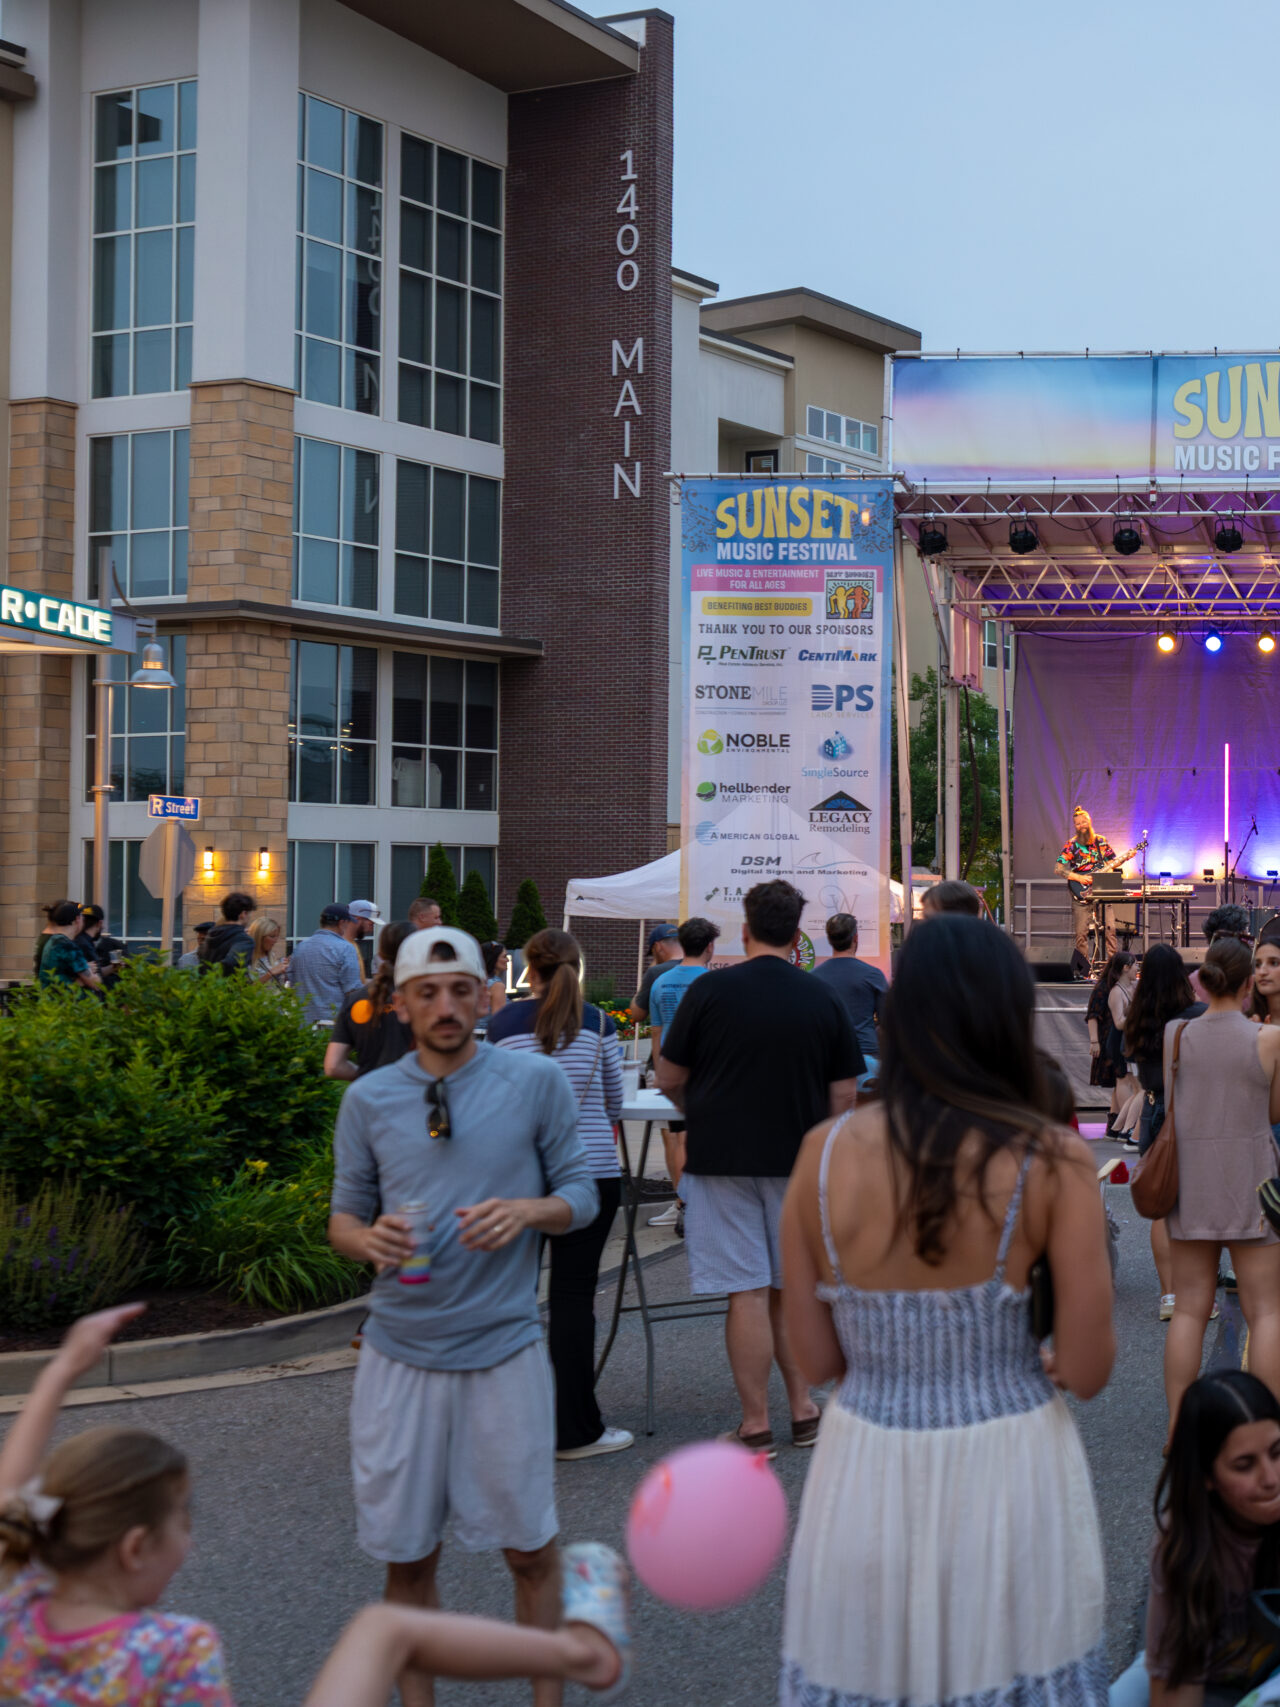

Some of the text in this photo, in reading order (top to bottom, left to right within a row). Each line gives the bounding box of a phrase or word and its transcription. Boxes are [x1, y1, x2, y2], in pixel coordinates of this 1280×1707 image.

[616, 150, 640, 291] 1400
[612, 338, 644, 499] MAIN
[1175, 445, 1260, 471] MUSIC
[716, 486, 858, 539] SUNSET
[717, 543, 858, 560] MUSIC FESTIVAL
[696, 569, 819, 578] LIVE MUSIC & ENTERTAINMENT
[730, 580, 786, 590] FOR ALL AGES
[708, 602, 808, 611] BENEFITING BEST BUDDIES
[698, 624, 874, 635] THANK YOU TO OUR SPONSORS
[812, 684, 874, 712] DPS
[726, 734, 790, 748] NOBLE
[720, 783, 790, 794] hellbender
[722, 794, 788, 803] MARKETING
[152, 798, 196, 815] R Street
[808, 812, 872, 823] LEGACY
[809, 824, 870, 834] Remodeling
[741, 856, 782, 866] DSM
